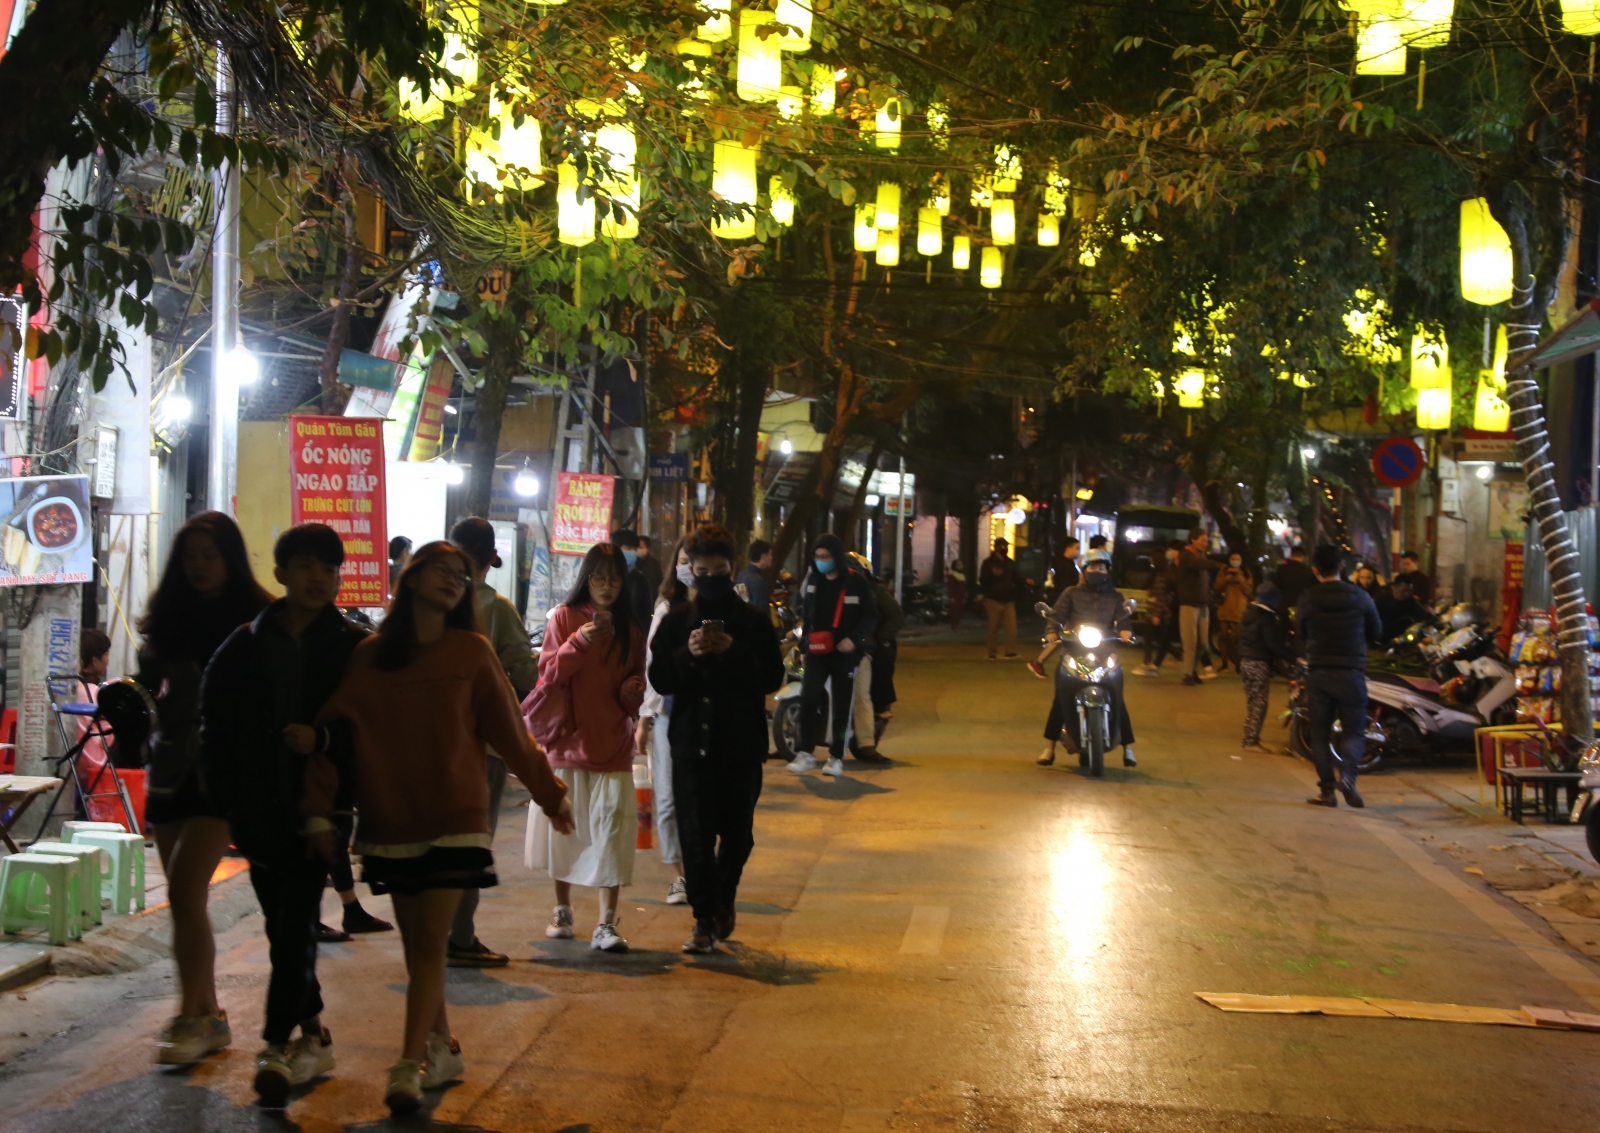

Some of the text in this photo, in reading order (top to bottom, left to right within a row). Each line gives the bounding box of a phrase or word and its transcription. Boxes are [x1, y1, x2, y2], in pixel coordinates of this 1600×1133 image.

[297, 422, 325, 437] Quán
[328, 422, 352, 436] Tôm
[302, 440, 372, 465] ỐC NÓNG
[296, 467, 378, 492] NGAO HẤP
[302, 496, 334, 512] TRỨNG
[336, 496, 353, 512] CÚT
[360, 561, 379, 578] LOẠI
[361, 581, 382, 591] BẠC
[342, 593, 360, 602] 379
[361, 593, 381, 603] 682
